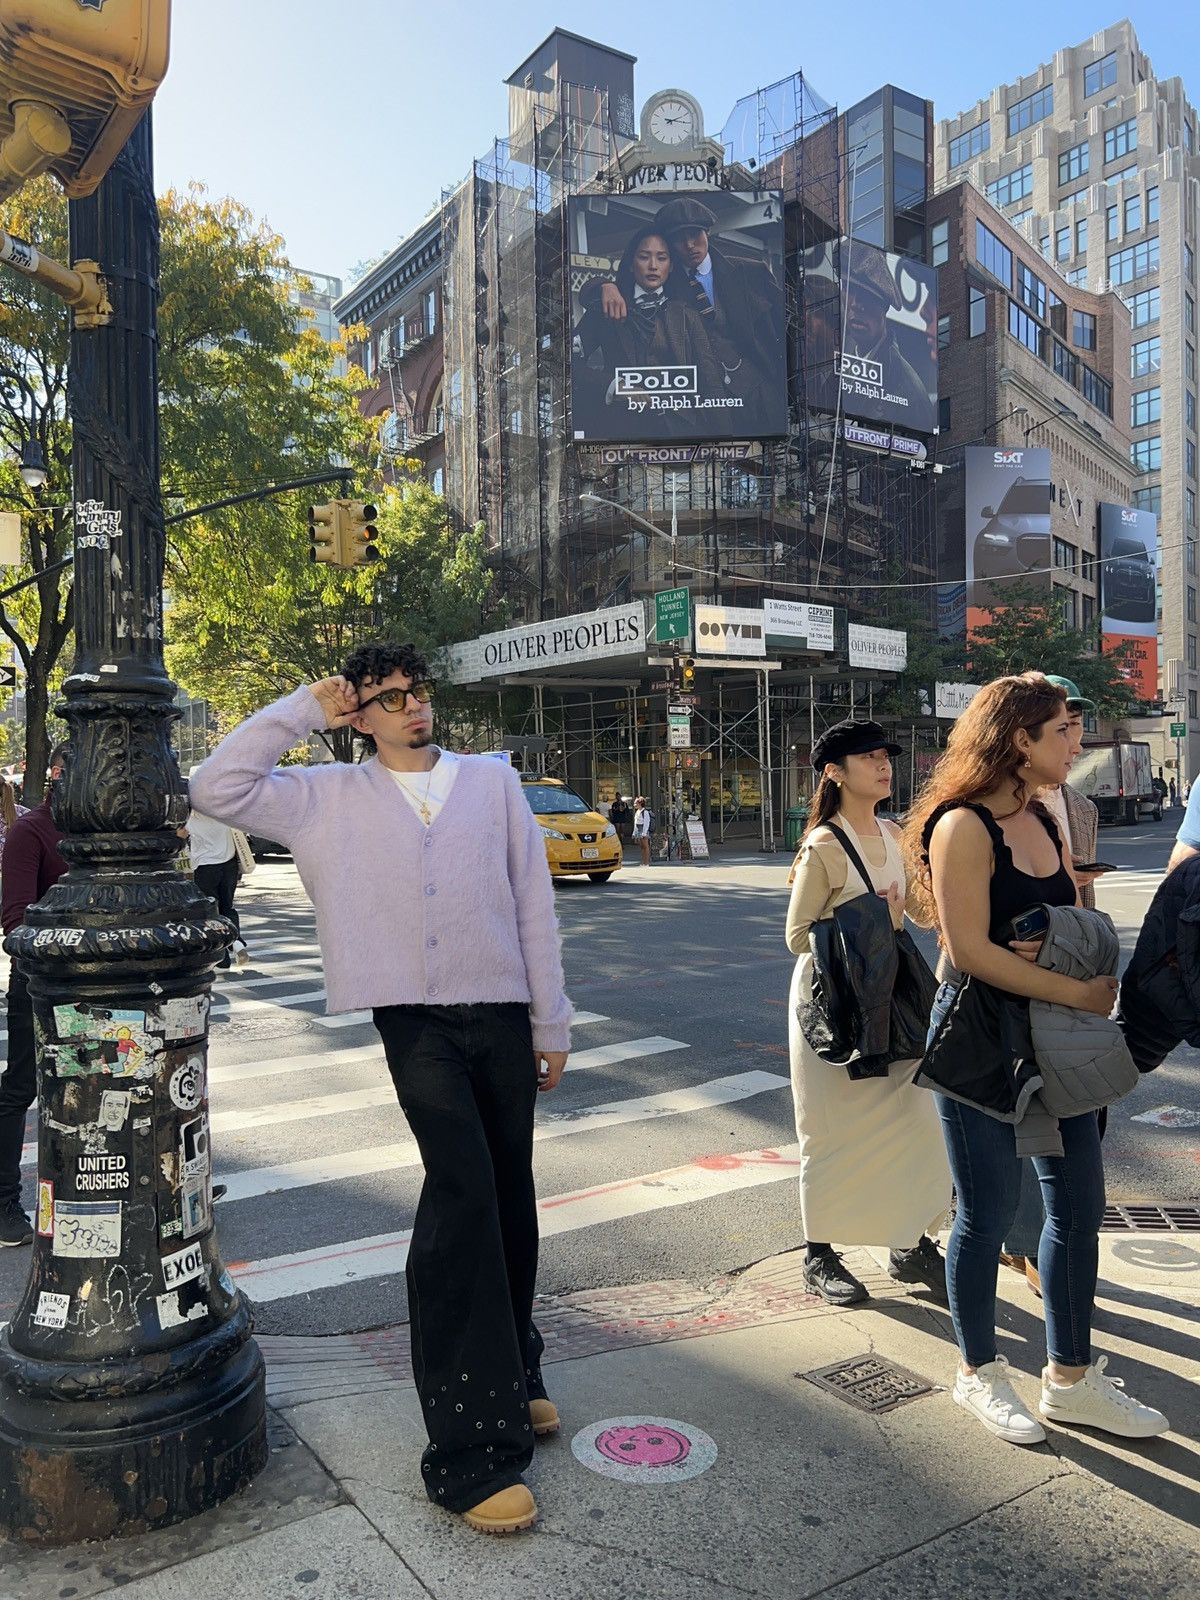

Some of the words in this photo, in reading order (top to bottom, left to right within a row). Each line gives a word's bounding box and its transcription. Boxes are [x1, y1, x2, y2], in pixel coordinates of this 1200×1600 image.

[763, 205, 773, 219] 4
[838, 357, 878, 380] Polo
[622, 371, 689, 389] Polo
[841, 379, 854, 394] by
[854, 382, 880, 399] Ralph
[881, 388, 909, 406] Lauren
[627, 397, 647, 413] by
[650, 396, 692, 410] Ralph
[694, 395, 744, 408] Lauren
[893, 438, 919, 453] PRIME
[605, 448, 692, 463] OUTFRONT
[700, 446, 745, 460] PRIME
[658, 591, 686, 603] HOLLAND
[661, 601, 684, 612] TUNNEL
[773, 602, 787, 610] Watts
[787, 603, 802, 612] Street
[485, 632, 550, 667] OLIVER
[552, 614, 640, 654] PEOPLES
[851, 639, 877, 654] OLIVER
[878, 643, 906, 657] PEOPLES
[78, 1155, 126, 1172] UNITED
[75, 1172, 129, 1191] CRUSHERS
[40, 1294, 68, 1309] FRIENDS
[48, 1318, 63, 1326] YORK
